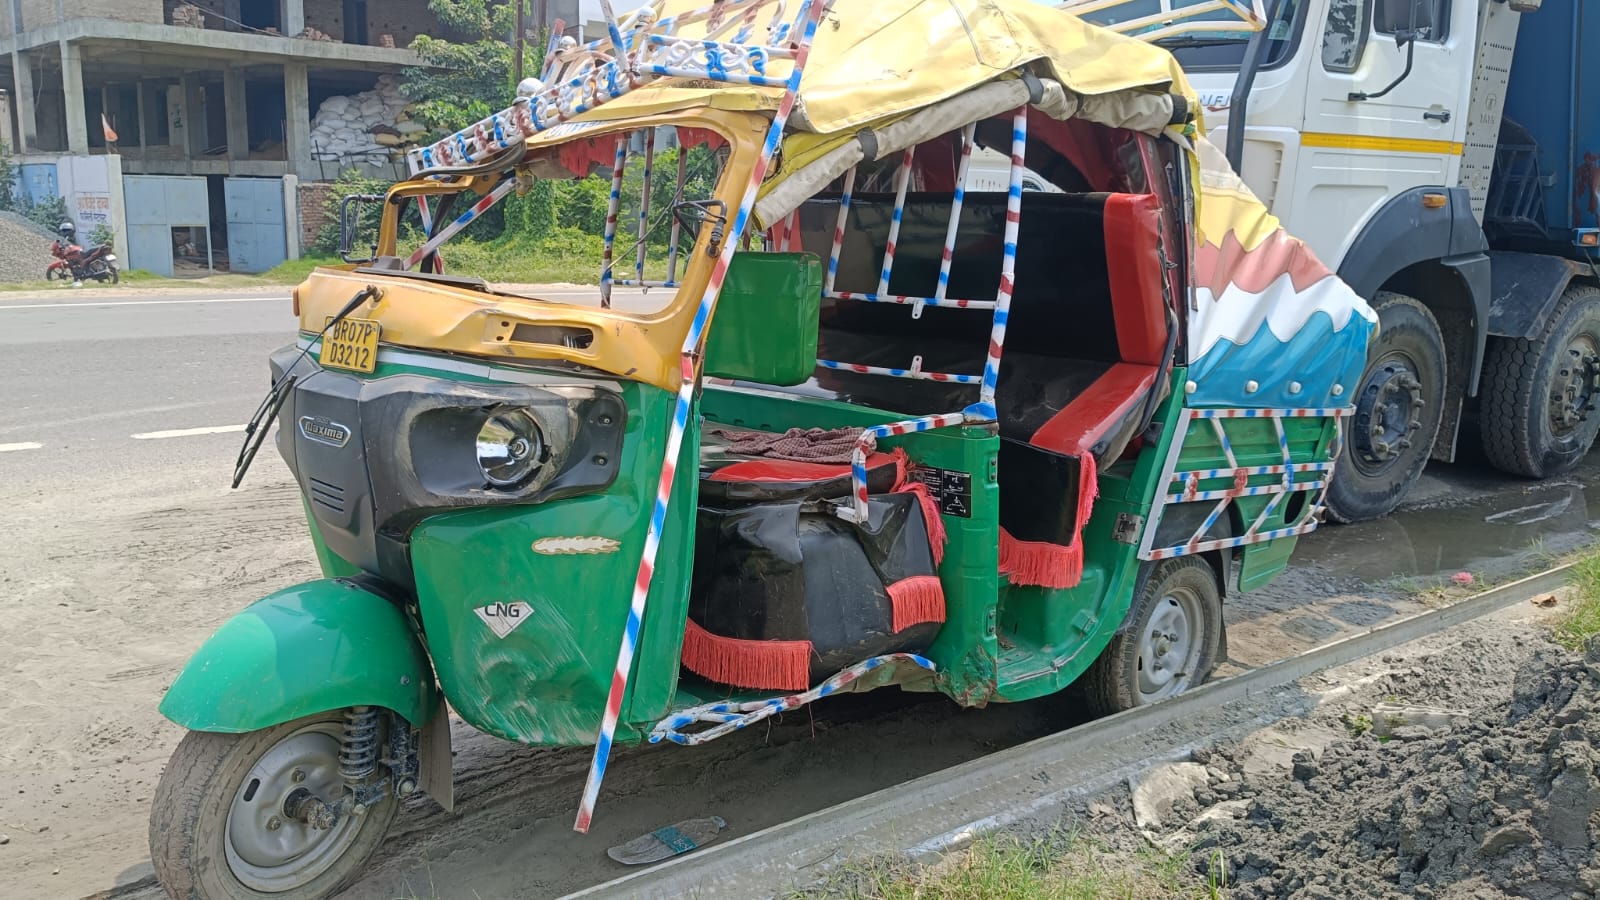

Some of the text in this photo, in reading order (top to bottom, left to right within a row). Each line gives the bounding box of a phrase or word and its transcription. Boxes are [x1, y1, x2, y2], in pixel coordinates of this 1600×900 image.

[333, 320, 372, 344] BR07P
[330, 342, 369, 368] D3212
[485, 603, 520, 617] CNG
